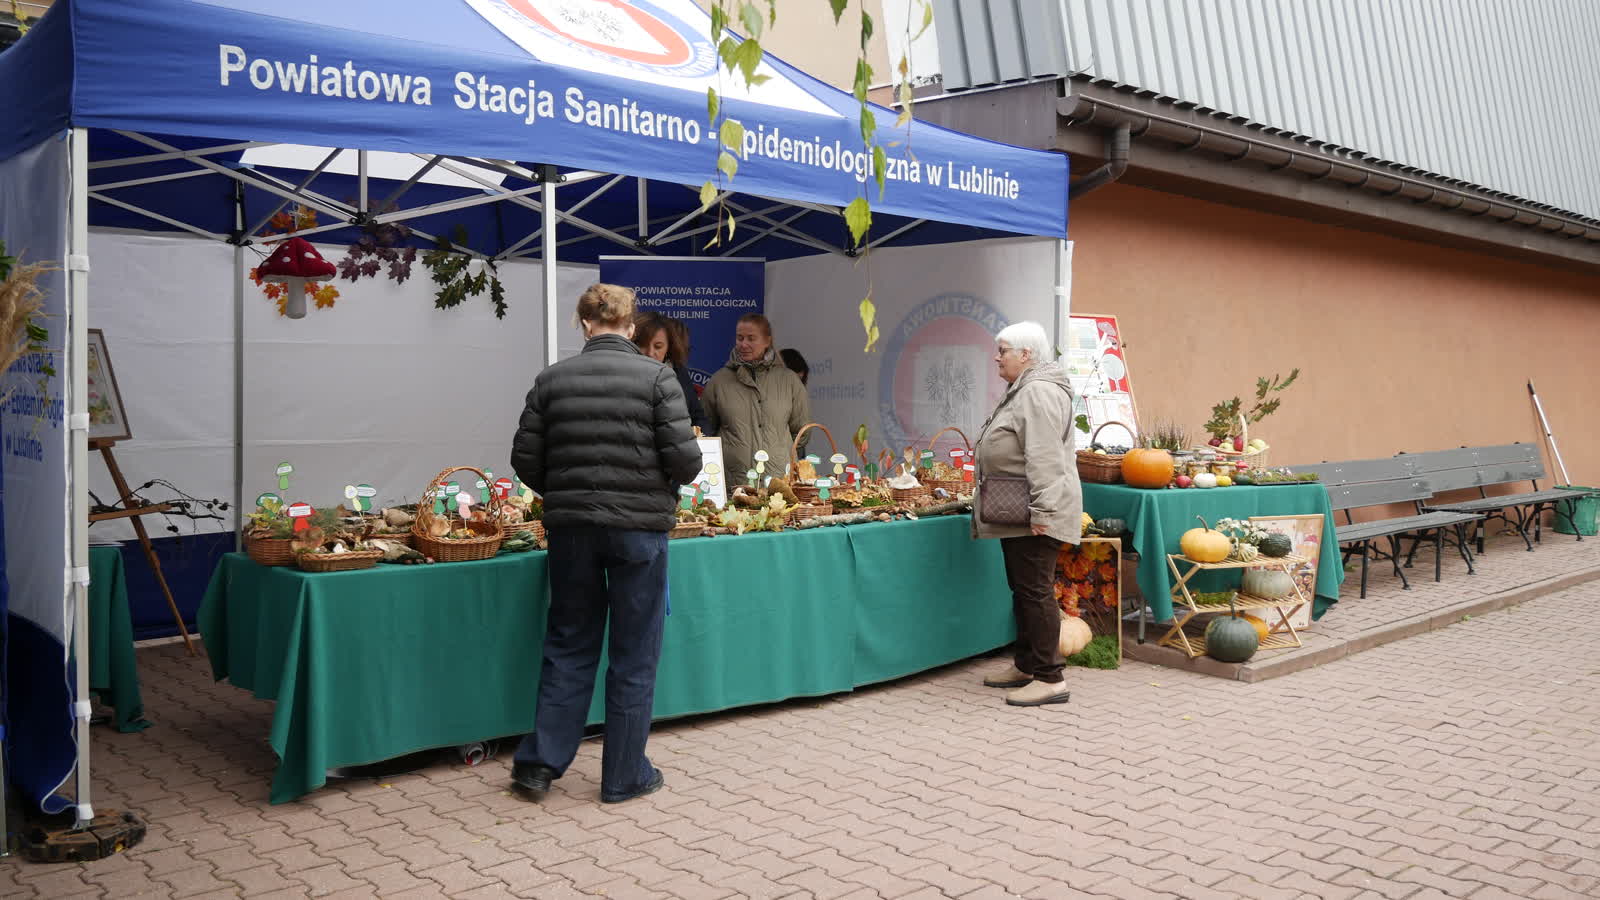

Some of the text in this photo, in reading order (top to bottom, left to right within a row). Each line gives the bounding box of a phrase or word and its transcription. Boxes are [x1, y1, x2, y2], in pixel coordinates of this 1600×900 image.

[218, 44, 1019, 200] Powiatowa Stacja Sanitarno - pidemiologizna w Lublinie
[634, 286, 731, 296] POWIATOWA STACJA
[634, 298, 757, 307] ARNO-EPIDEMIOLOGICZNA
[667, 311, 710, 319] LUBLINIE
